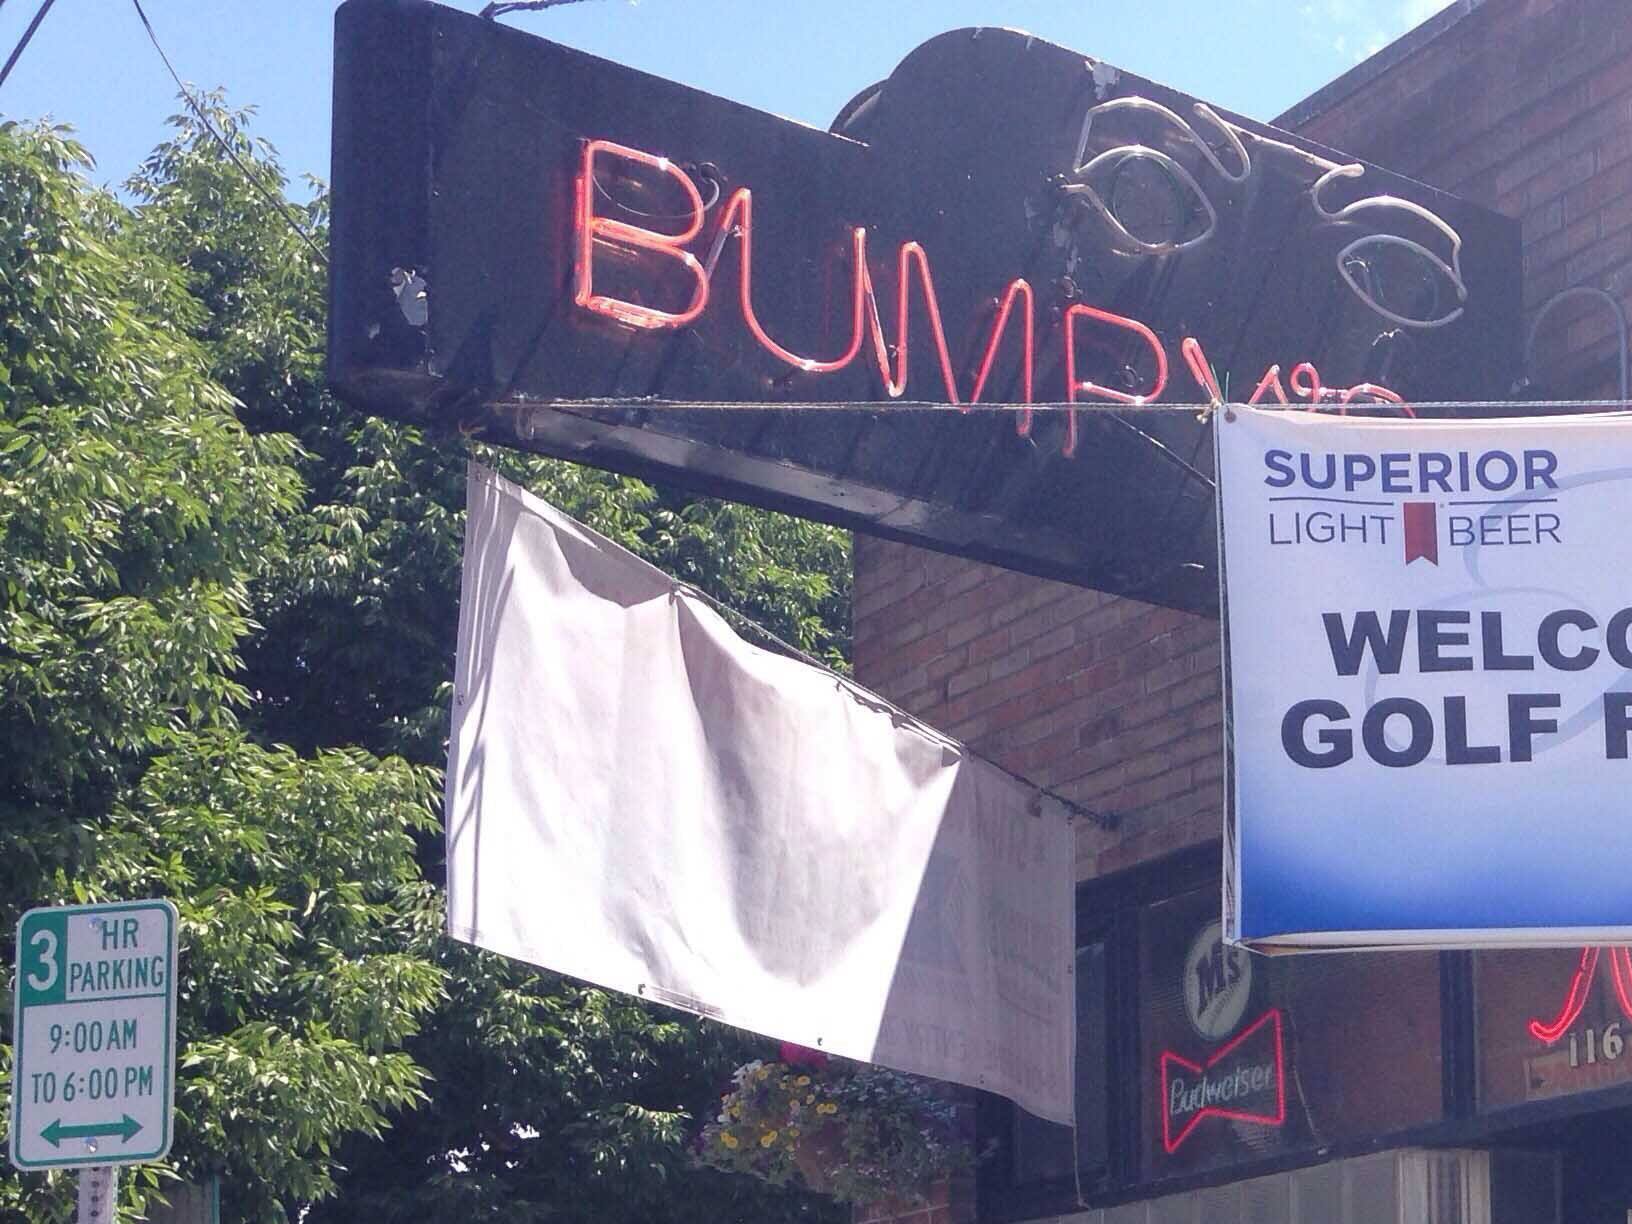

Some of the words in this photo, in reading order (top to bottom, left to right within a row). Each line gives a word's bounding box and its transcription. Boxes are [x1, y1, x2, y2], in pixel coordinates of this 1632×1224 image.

[1263, 449, 1559, 493] SUPERIOR
[1269, 511, 1395, 544] LIGHT
[1449, 513, 1562, 546] BEER
[1281, 692, 1562, 769] GOLF
[101, 917, 139, 951] HR
[28, 929, 59, 992] 3
[69, 956, 164, 993] PARKING
[50, 1021, 102, 1054] 9:00
[106, 1019, 137, 1051] AM
[1568, 1023, 1624, 1067] 116
[32, 1072, 56, 1104] TO
[63, 1066, 118, 1102] 6:00
[125, 1065, 153, 1097] PM
[1169, 1063, 1275, 1116] Budweiser
